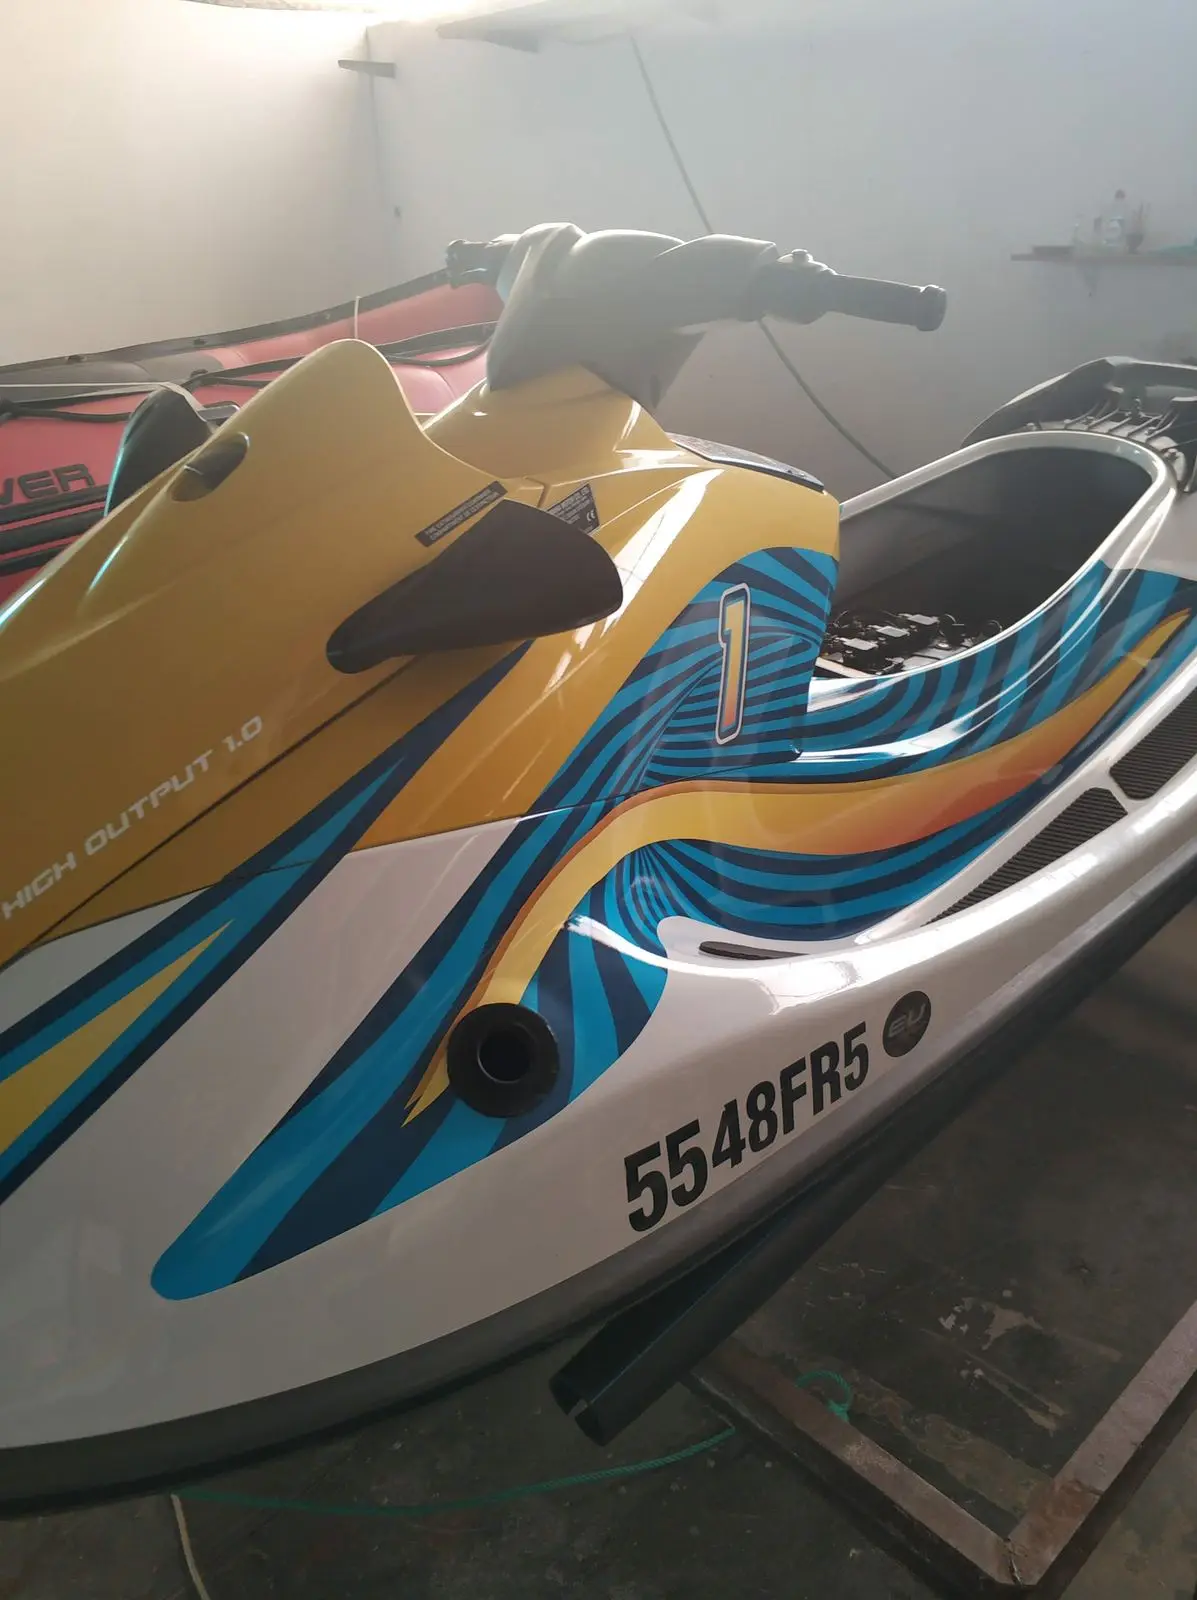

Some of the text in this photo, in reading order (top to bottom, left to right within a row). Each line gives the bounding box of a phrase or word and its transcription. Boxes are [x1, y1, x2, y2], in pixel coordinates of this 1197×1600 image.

[716, 582, 751, 745] 1
[2, 715, 263, 919] HIGH OUTPUT 1.0
[624, 1021, 869, 1232] 5548FR5
